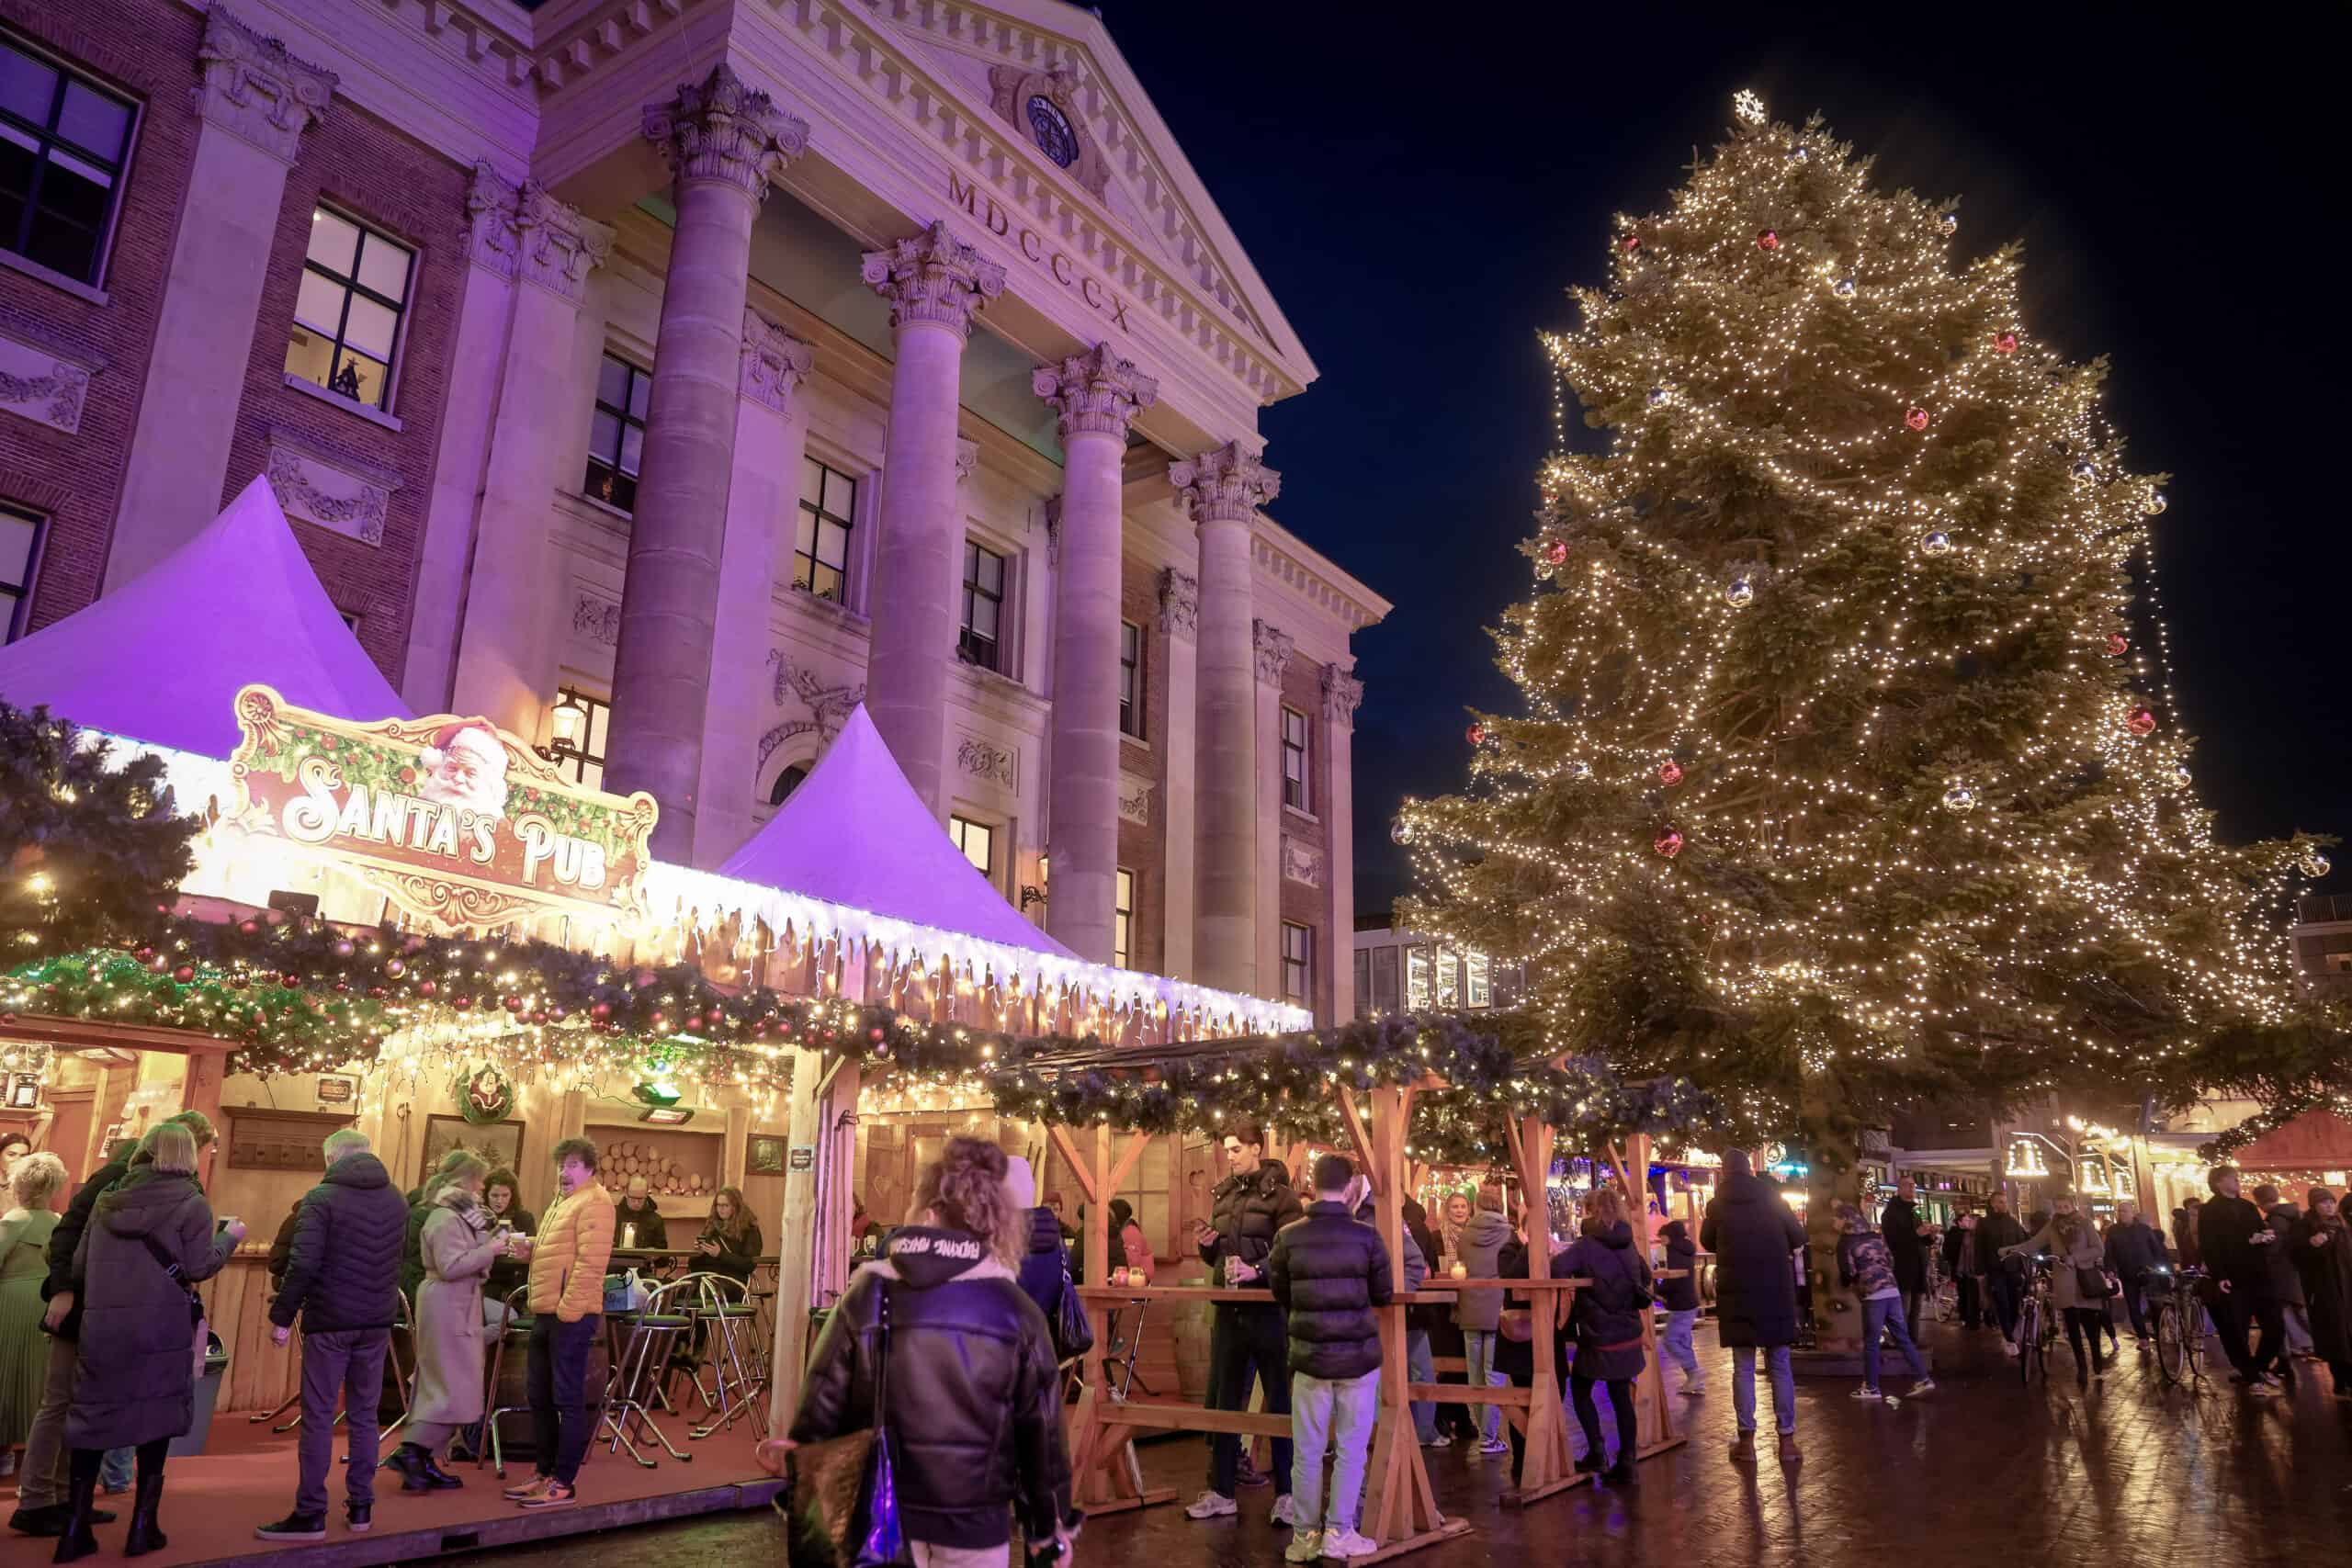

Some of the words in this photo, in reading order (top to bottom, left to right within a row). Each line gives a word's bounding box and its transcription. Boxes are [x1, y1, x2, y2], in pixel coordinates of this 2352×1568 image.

[949, 170, 1129, 333] MDCCCX
[283, 757, 497, 866] SANTA'S
[514, 813, 606, 890] PUB
